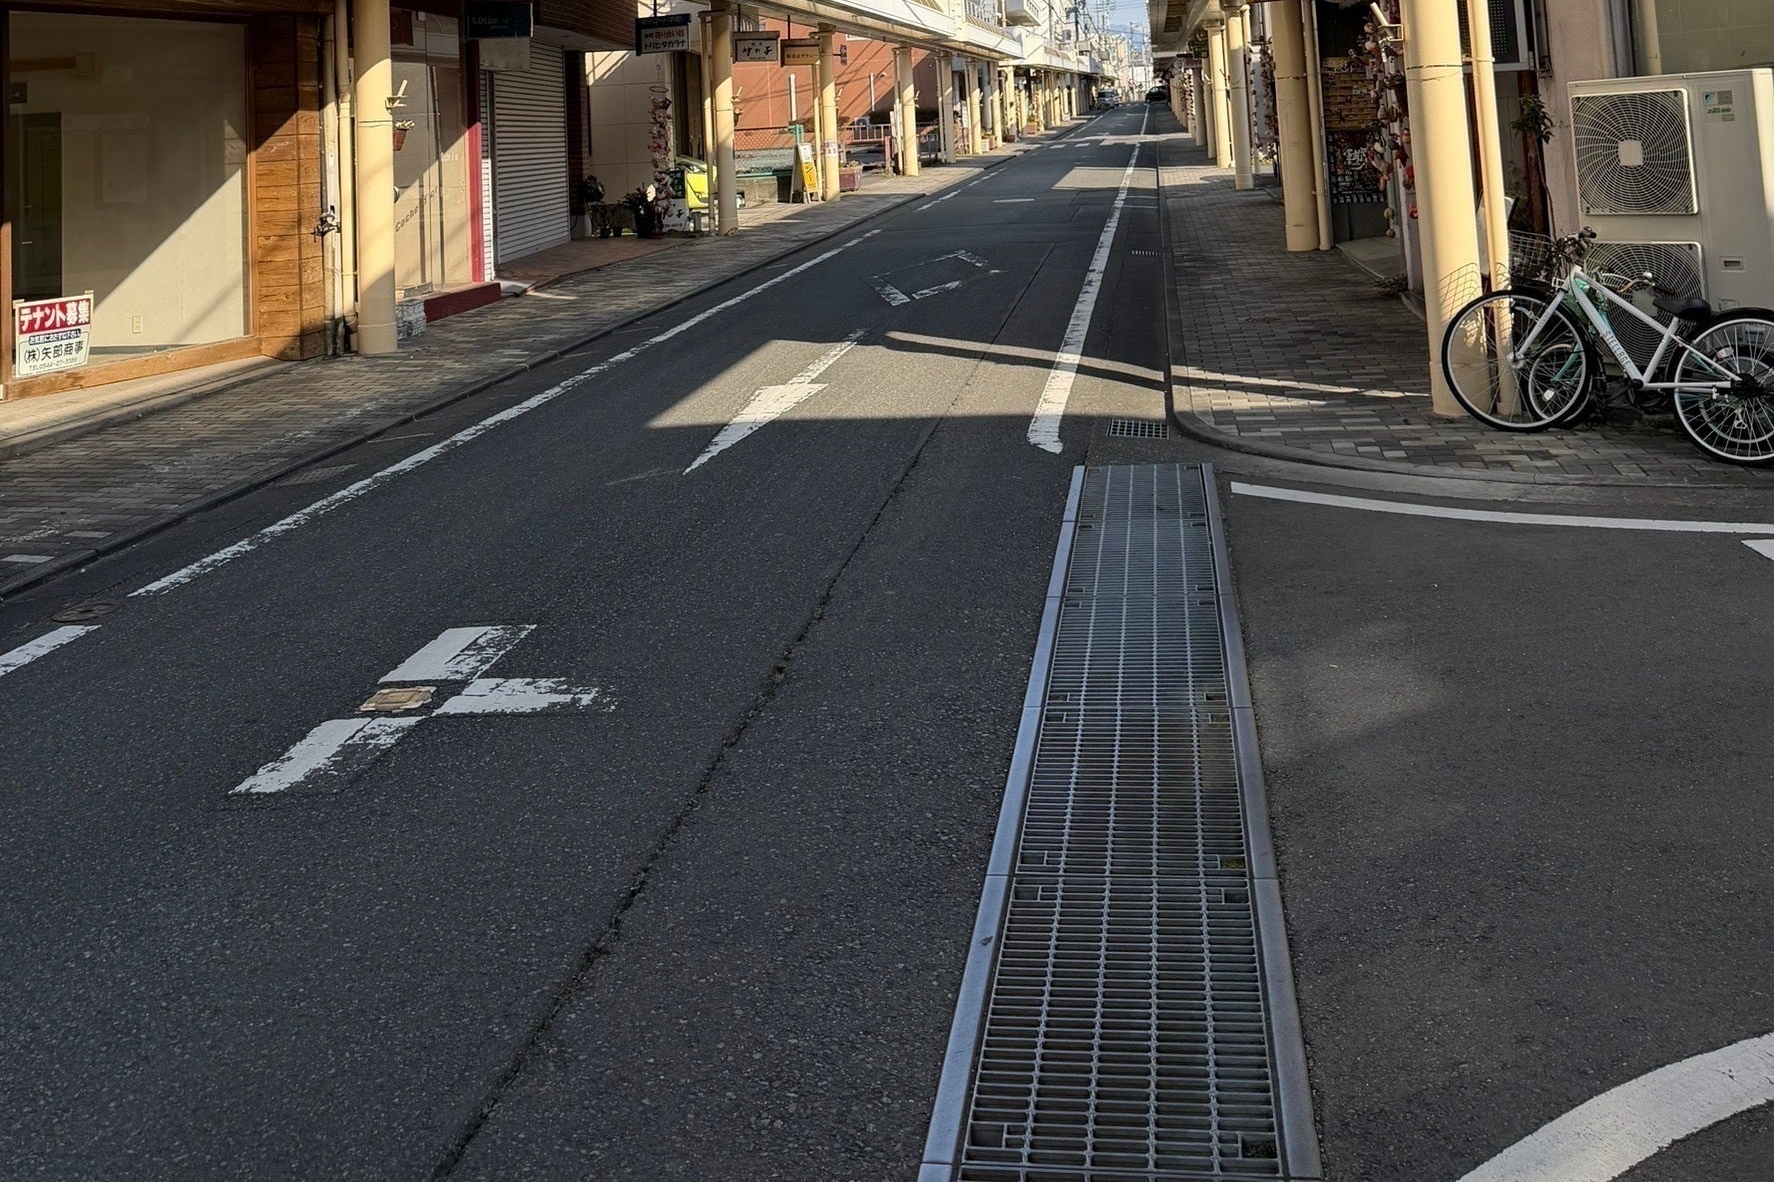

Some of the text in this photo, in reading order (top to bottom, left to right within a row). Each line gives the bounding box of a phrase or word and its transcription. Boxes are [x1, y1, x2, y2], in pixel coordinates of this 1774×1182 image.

[20, 299, 90, 332] テナント募集
[24, 340, 84, 363] (株)矢部商事
